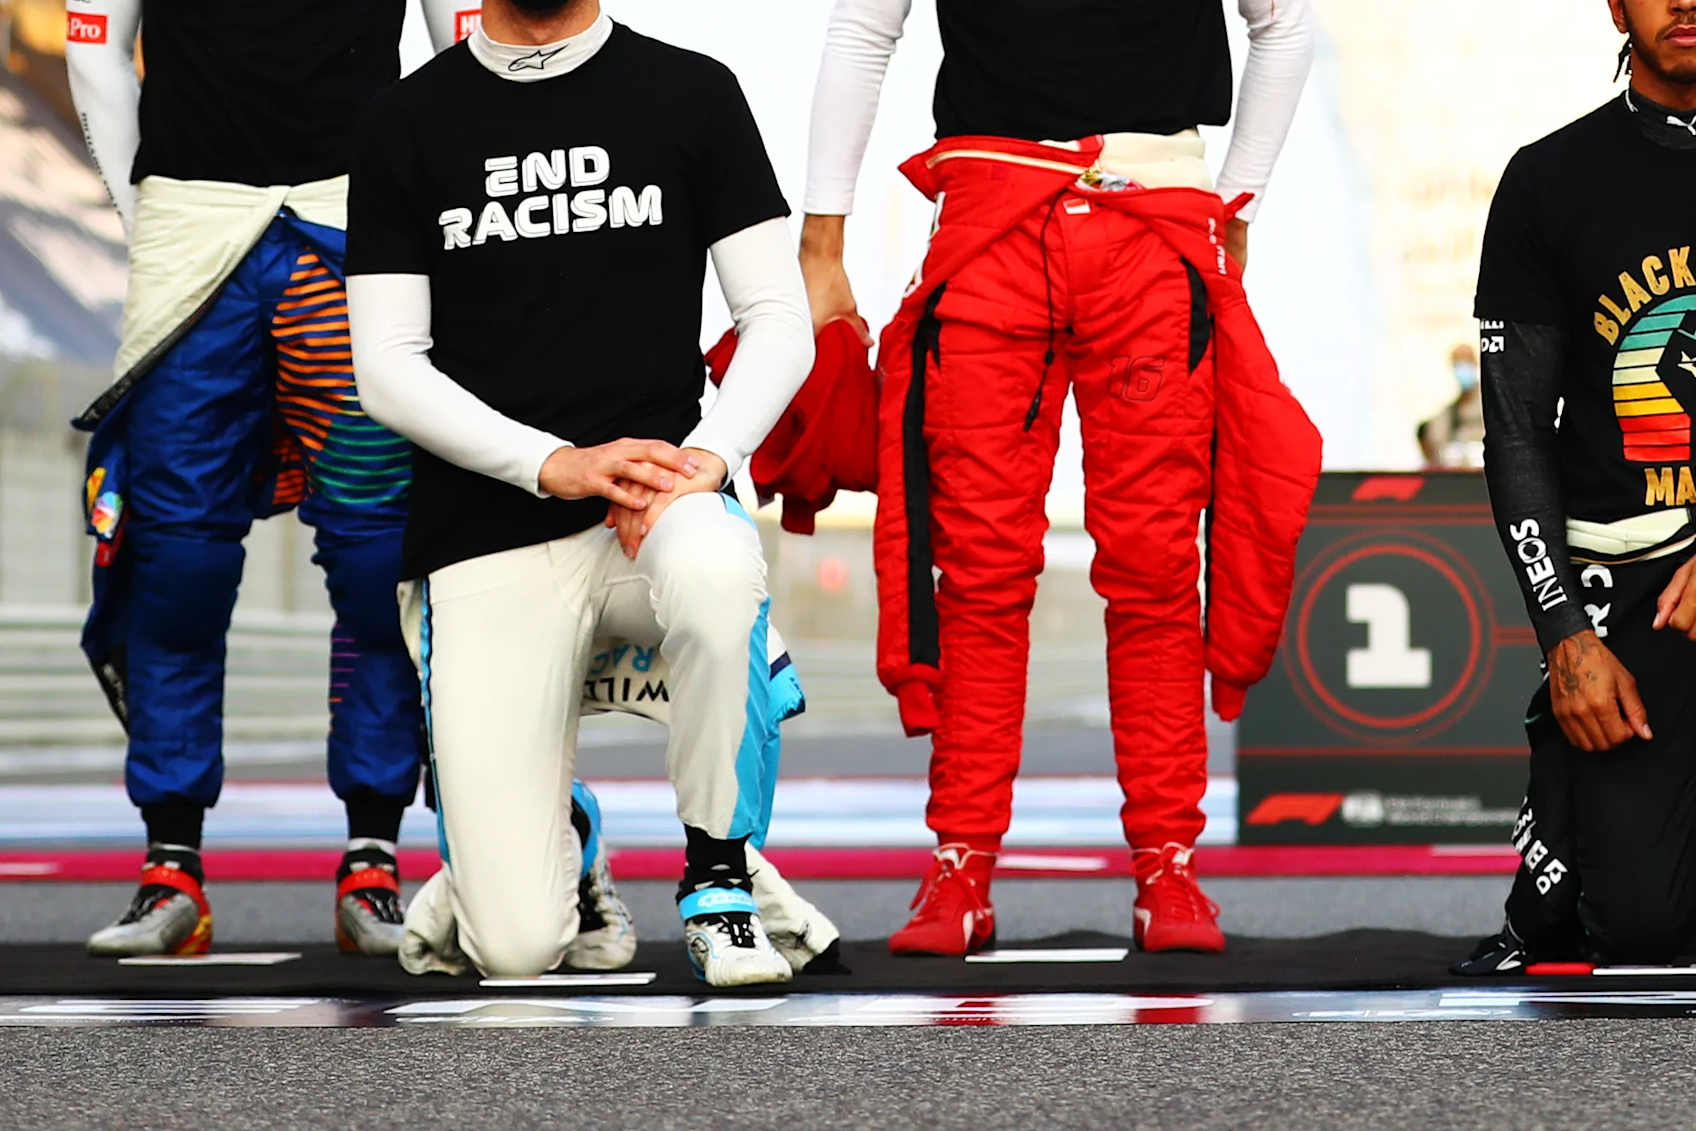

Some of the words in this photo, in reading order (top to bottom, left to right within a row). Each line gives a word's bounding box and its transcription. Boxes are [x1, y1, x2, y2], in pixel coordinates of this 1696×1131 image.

[67, 17, 102, 39] Pro
[485, 146, 611, 198] END
[439, 185, 663, 251] RACISM
[1108, 354, 1165, 402] 16
[1510, 518, 1568, 612] INEOS
[1346, 583, 1432, 688] 1
